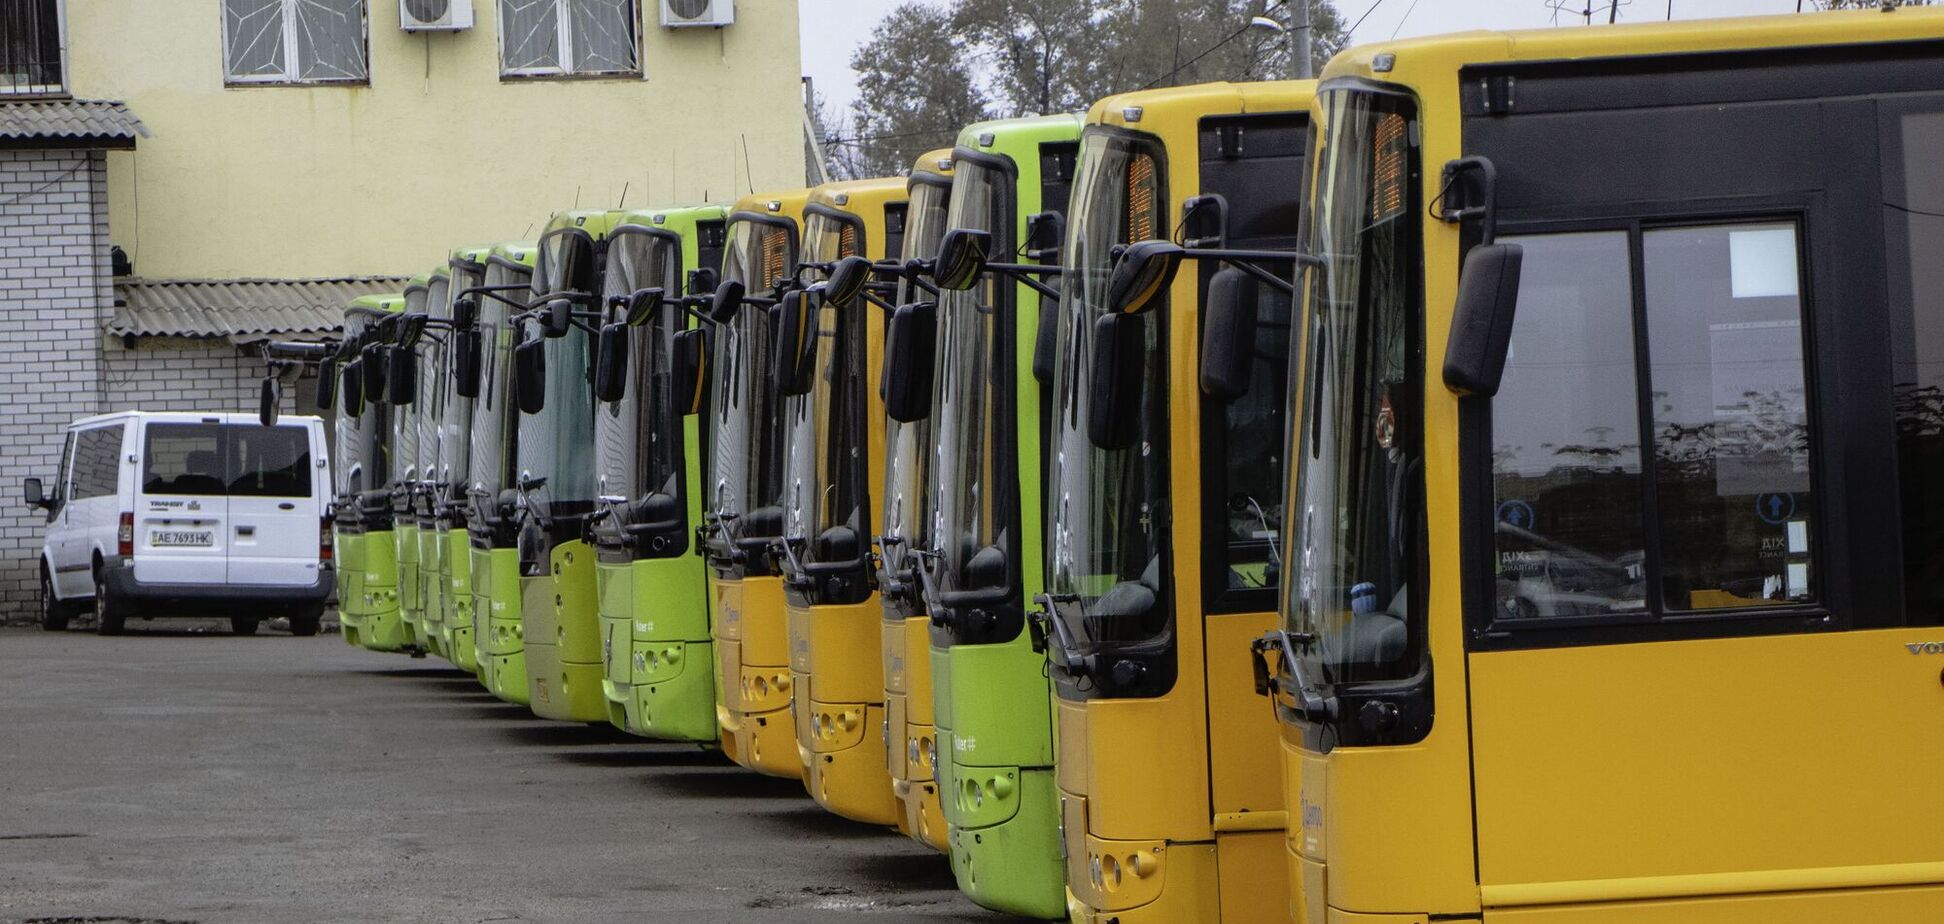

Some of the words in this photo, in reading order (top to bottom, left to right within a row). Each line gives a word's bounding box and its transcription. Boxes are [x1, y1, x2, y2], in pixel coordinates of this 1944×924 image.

[158, 532, 171, 543] AE
[173, 532, 194, 543] 7693
[195, 532, 209, 543] HK
